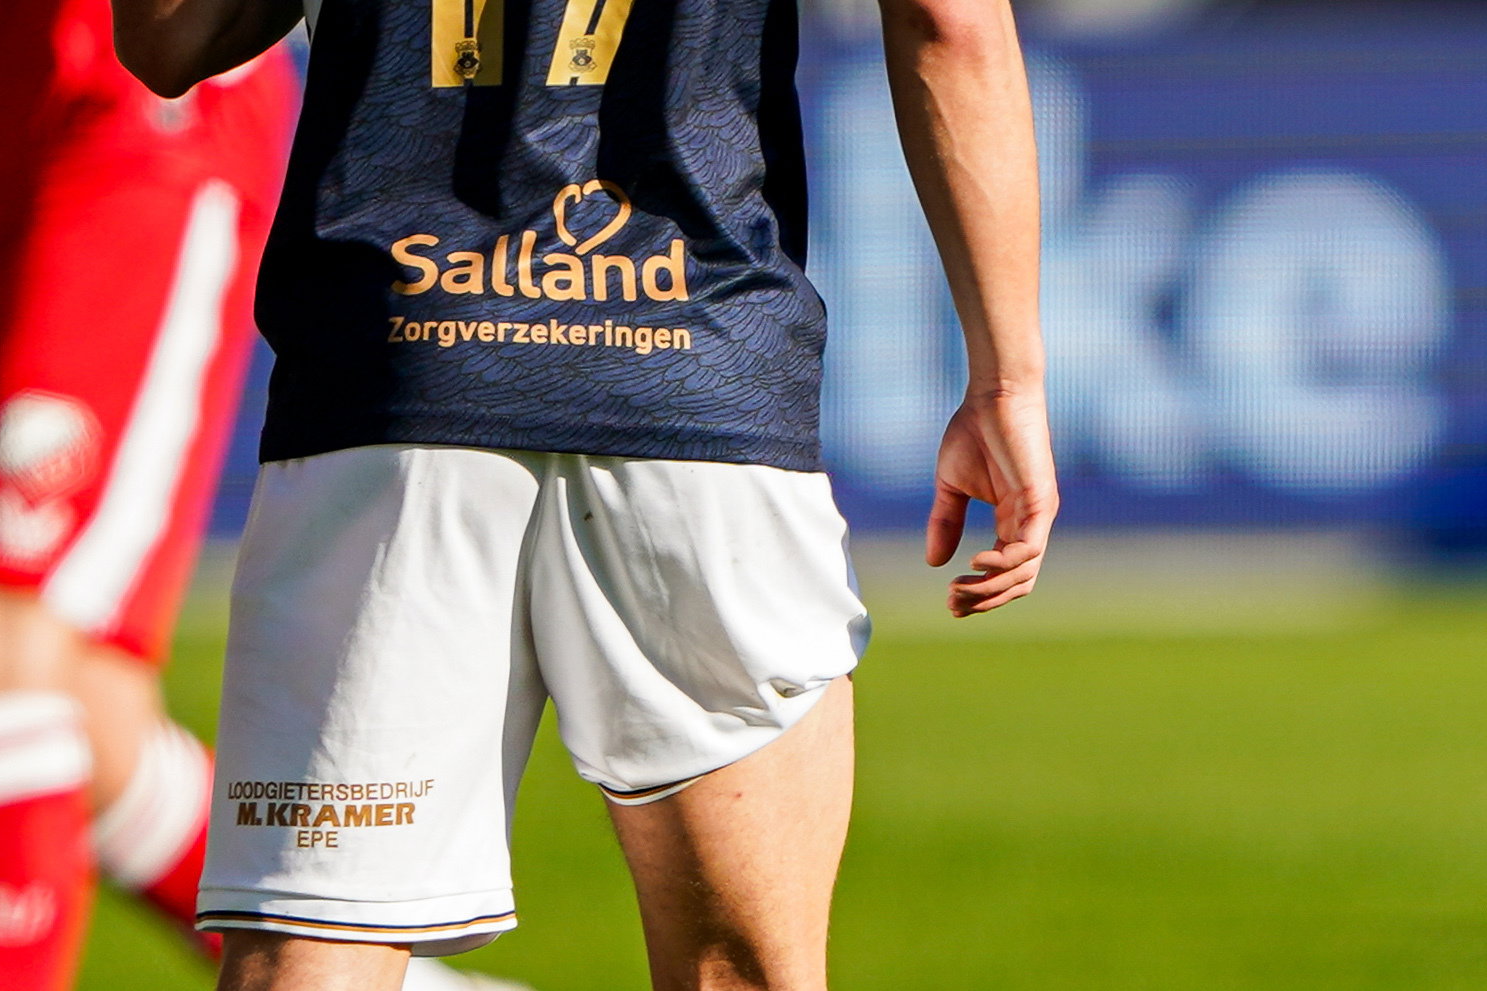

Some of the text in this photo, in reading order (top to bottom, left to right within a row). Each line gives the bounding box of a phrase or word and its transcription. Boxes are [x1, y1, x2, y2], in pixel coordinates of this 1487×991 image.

[390, 229, 690, 302] Salland
[387, 316, 692, 355] Zorgverzekeringen
[227, 778, 436, 801] LOODGIETERSBEDRIJF
[266, 801, 417, 828] KRAMER
[296, 830, 339, 848] EPE
